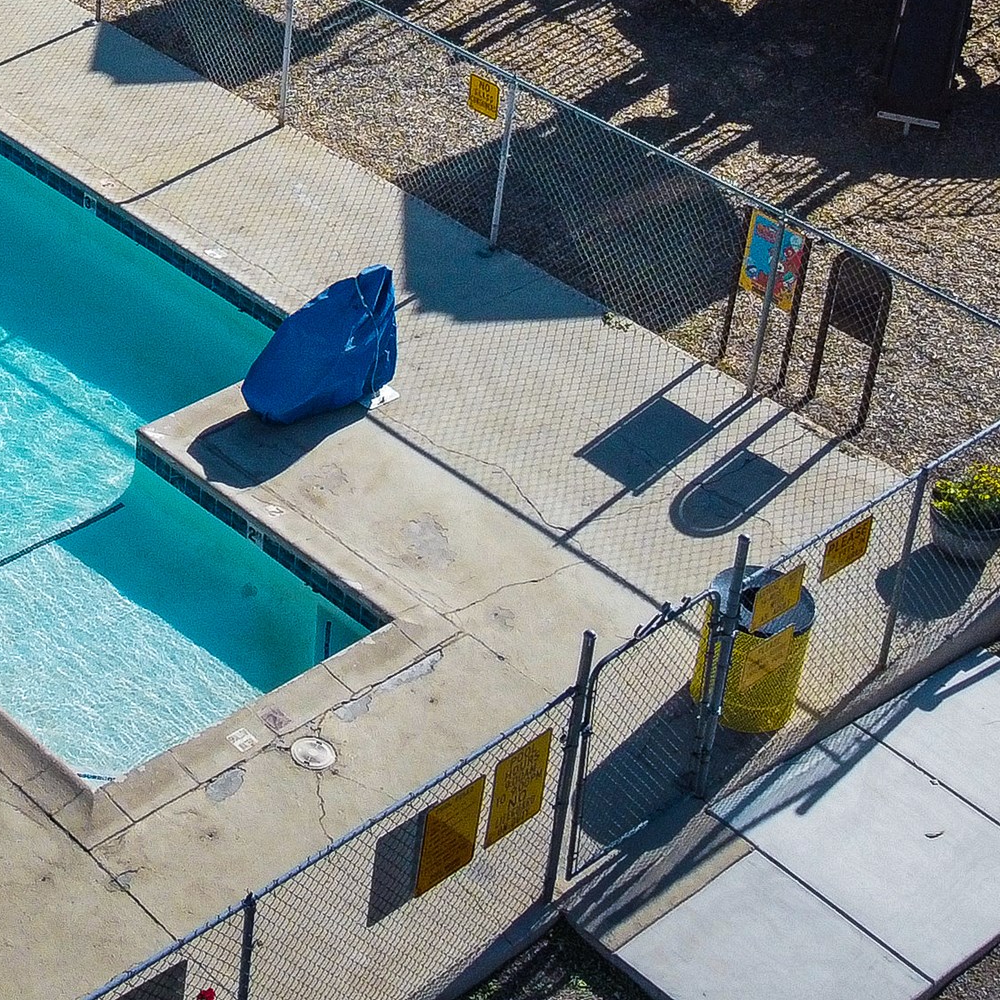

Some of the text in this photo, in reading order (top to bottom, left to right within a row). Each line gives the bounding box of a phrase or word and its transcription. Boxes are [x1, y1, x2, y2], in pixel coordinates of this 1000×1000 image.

[479, 80, 490, 93] NO
[828, 523, 868, 553] PLEASE
[508, 789, 527, 808] NO
